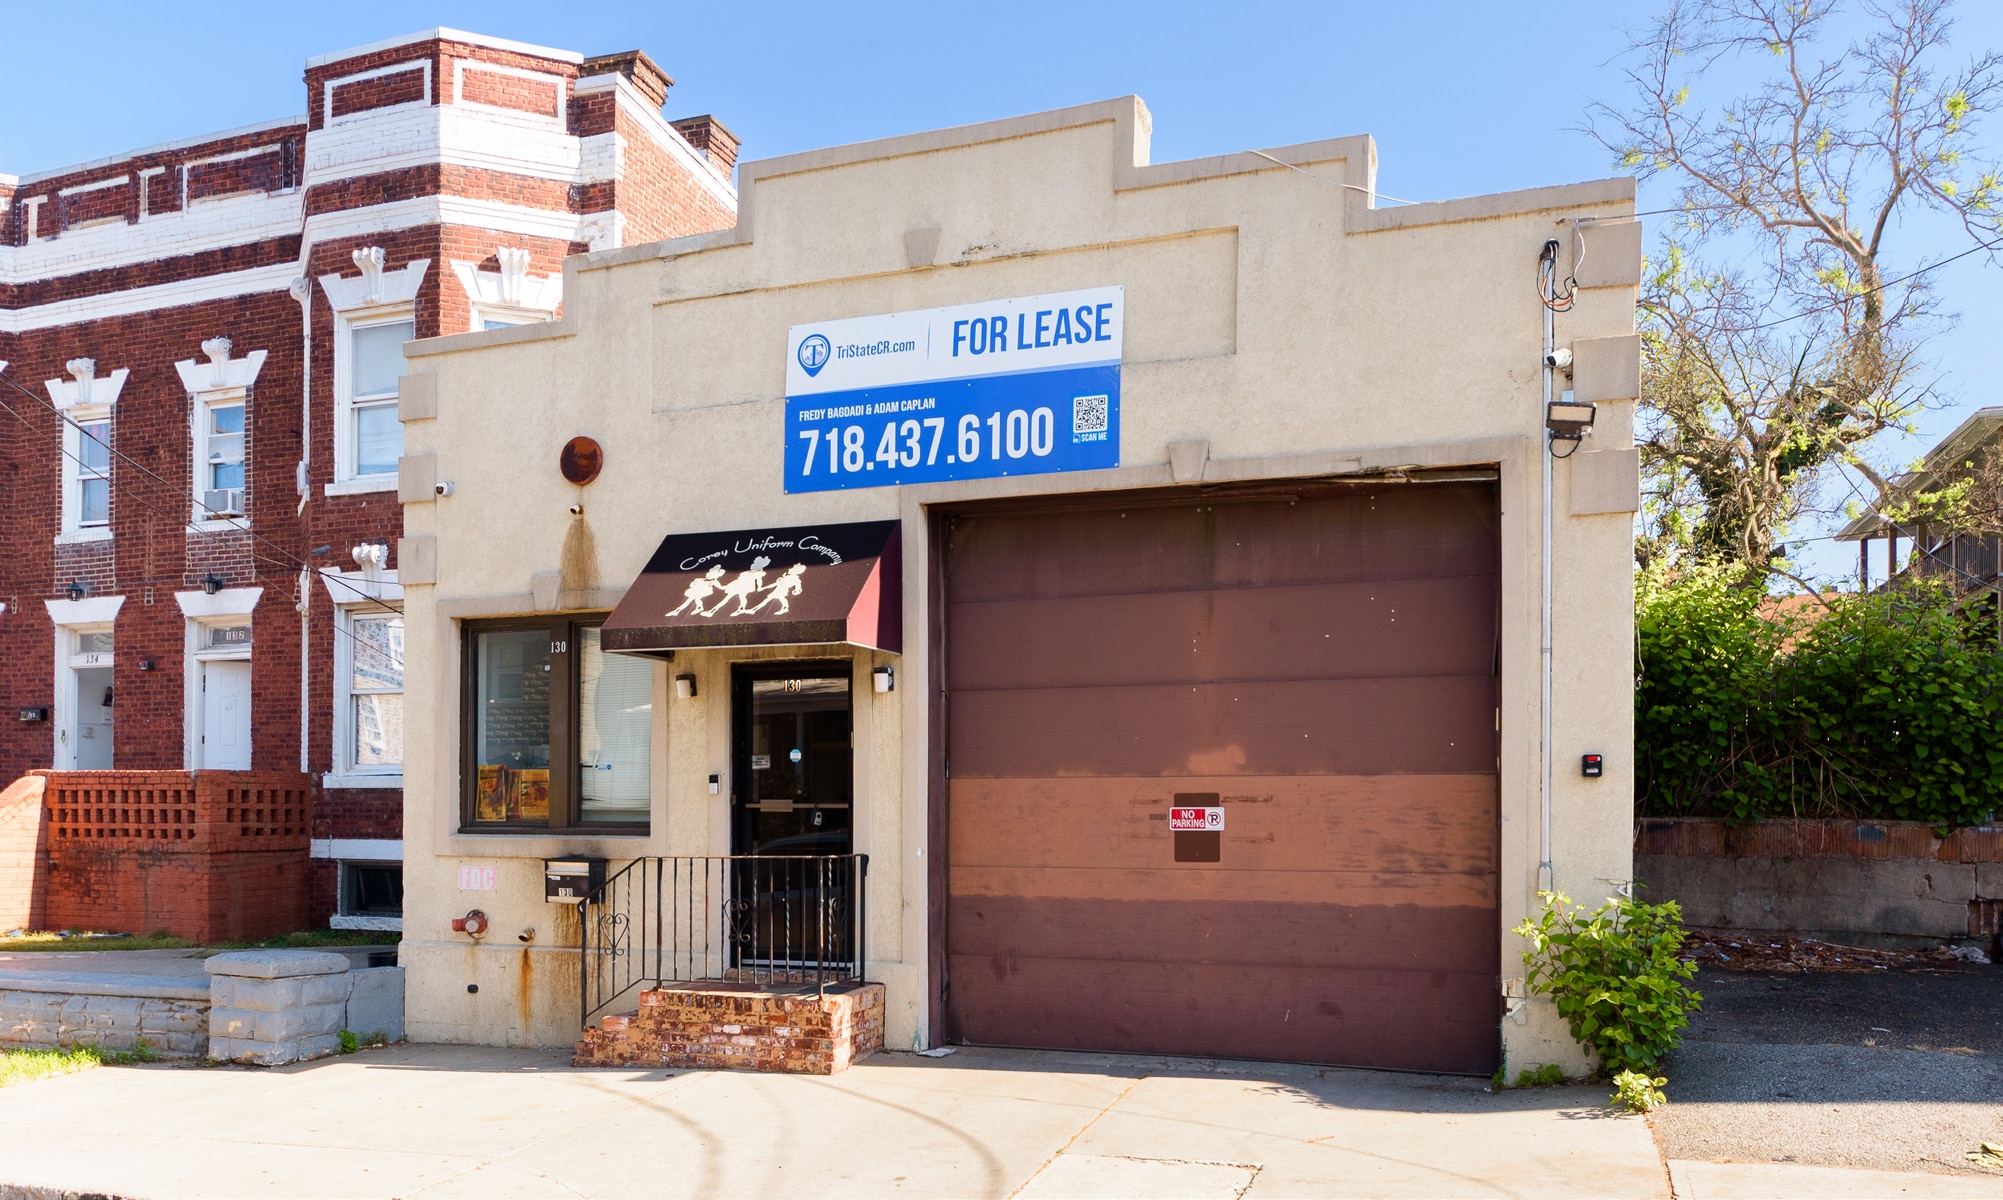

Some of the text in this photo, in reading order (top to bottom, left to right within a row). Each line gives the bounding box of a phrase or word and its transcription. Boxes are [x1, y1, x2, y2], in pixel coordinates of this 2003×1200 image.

[952, 302, 1114, 358] FOR LEASE
[836, 340, 915, 359] TriStateCR.com
[799, 397, 936, 422] FREDY BAGDADI & ADAM CAPLAN
[799, 406, 1054, 476] 718.437.6100
[1081, 431, 1108, 442] SCAN ME
[679, 535, 843, 571] Corey Uniform Company
[550, 640, 567, 653] 130
[784, 679, 801, 692] 130
[1181, 810, 1195, 819] NO
[1172, 819, 1205, 828] PARKING
[461, 868, 494, 888] FDC
[559, 888, 573, 897] 130
